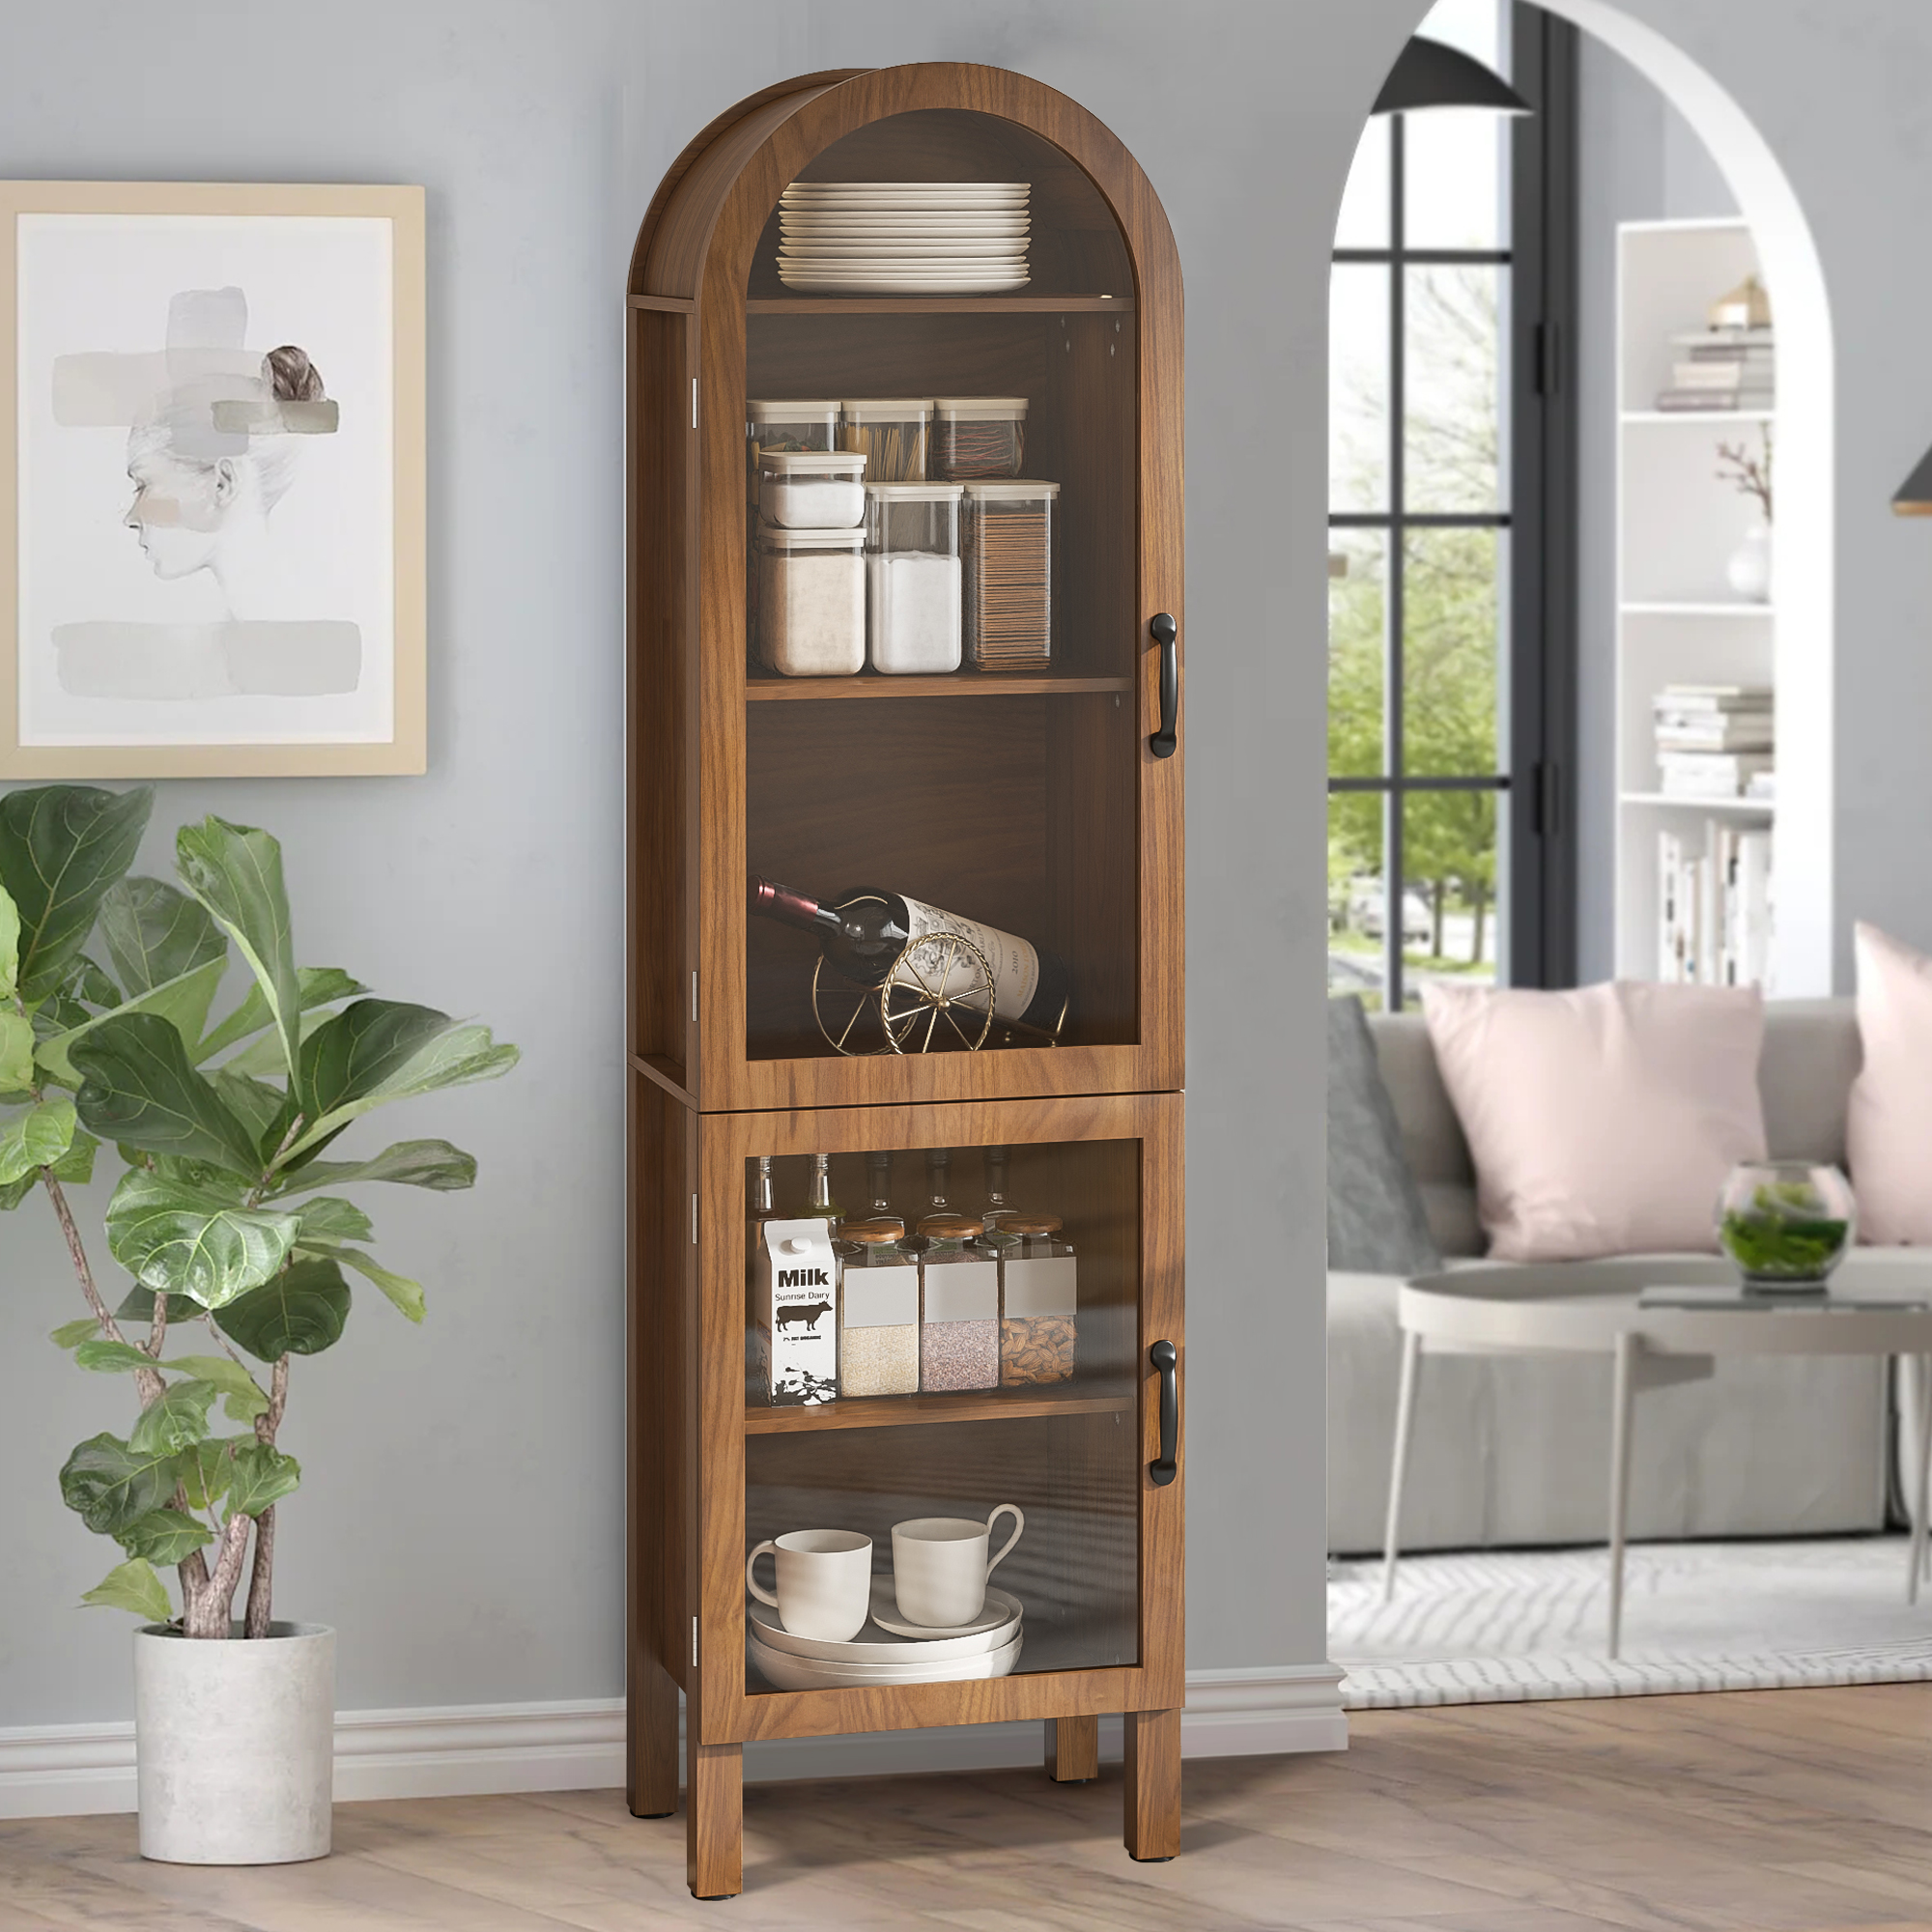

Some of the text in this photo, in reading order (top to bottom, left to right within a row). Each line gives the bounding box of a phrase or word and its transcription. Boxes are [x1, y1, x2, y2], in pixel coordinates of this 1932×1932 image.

[1017, 966, 1030, 997] MAISON
[779, 1267, 829, 1288] Milk
[775, 1292, 830, 1302] Sunrise Dairy
